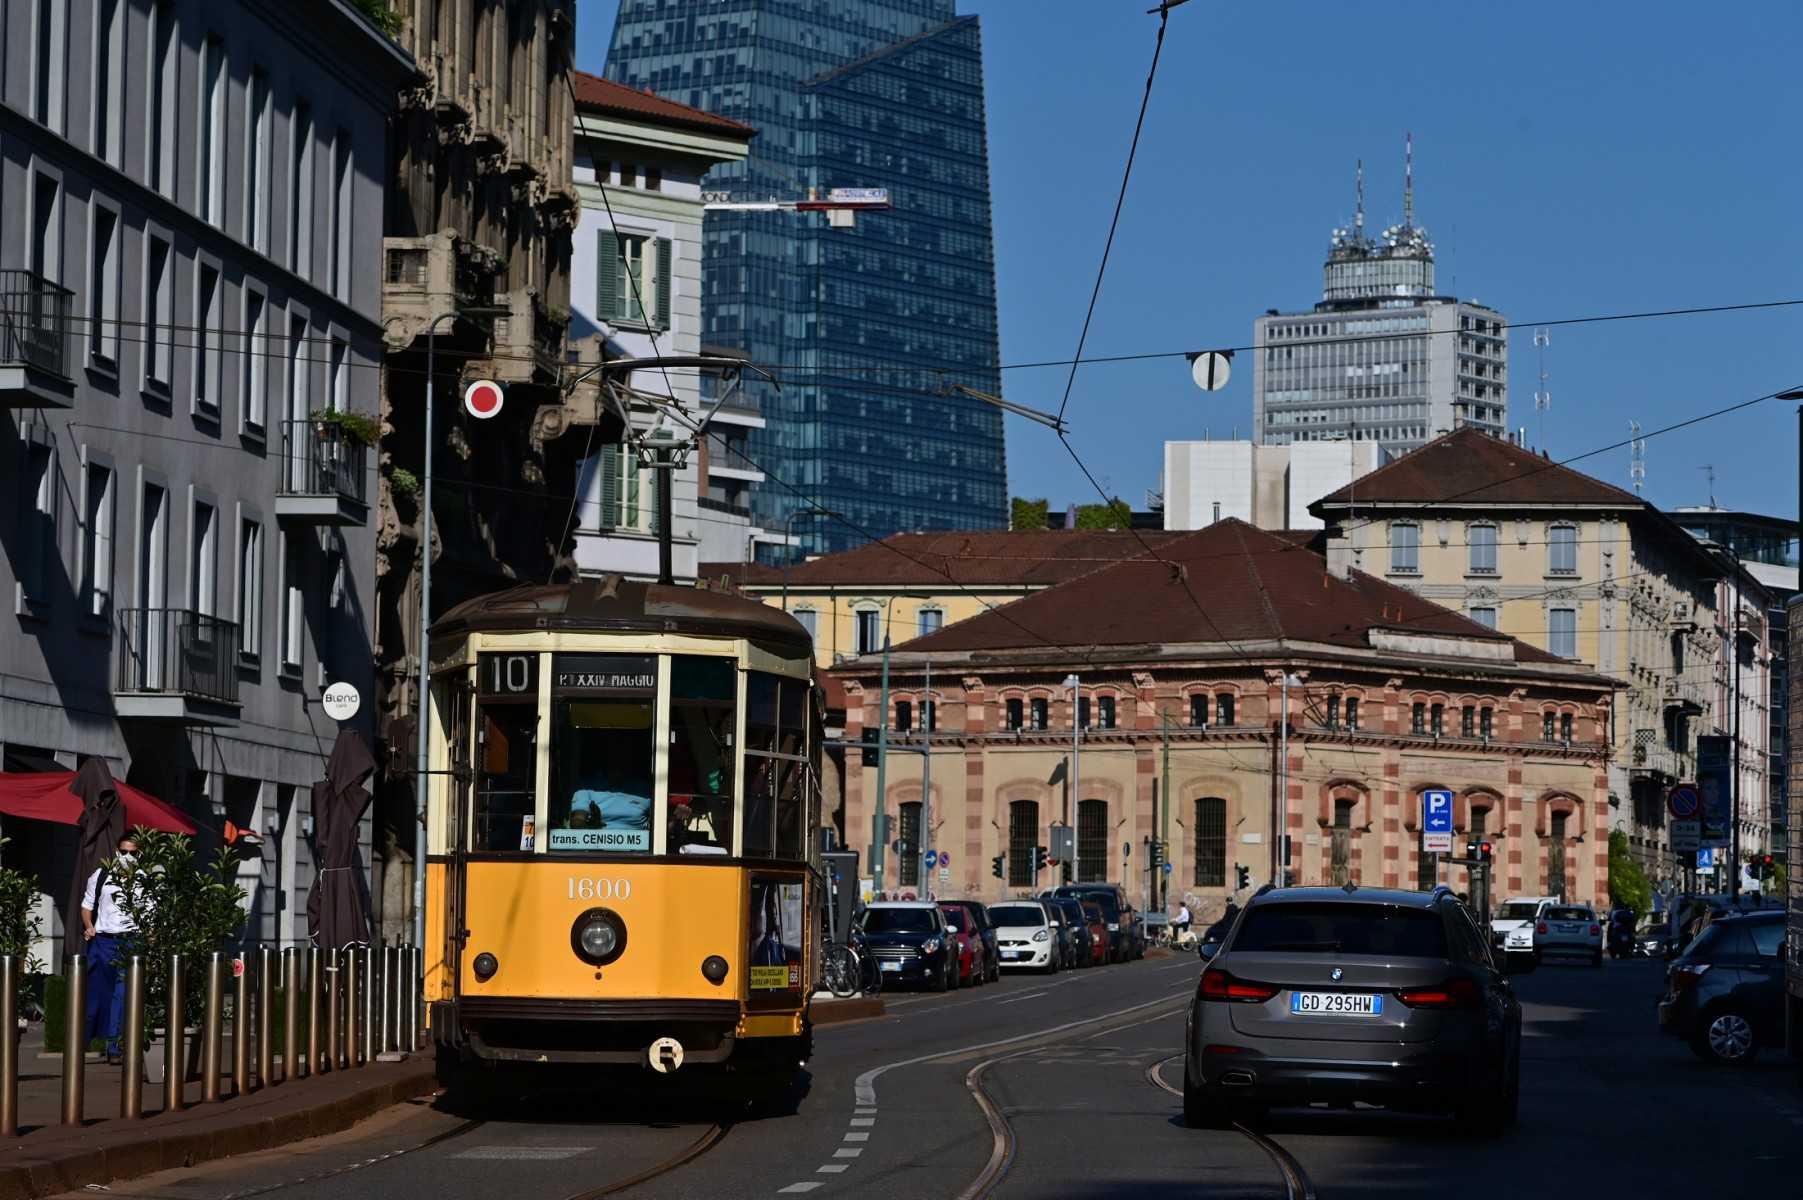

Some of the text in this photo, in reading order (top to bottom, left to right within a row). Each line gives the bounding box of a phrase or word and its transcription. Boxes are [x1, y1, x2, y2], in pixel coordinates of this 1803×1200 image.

[494, 655, 528, 693] 10
[577, 674, 606, 687] XXIV
[611, 674, 654, 687] MAGGIO
[1430, 793, 1446, 814] P
[552, 833, 641, 846] trans. CENISIO M5
[567, 877, 632, 901] 1600
[1301, 994, 1372, 1012] GD 295HW
